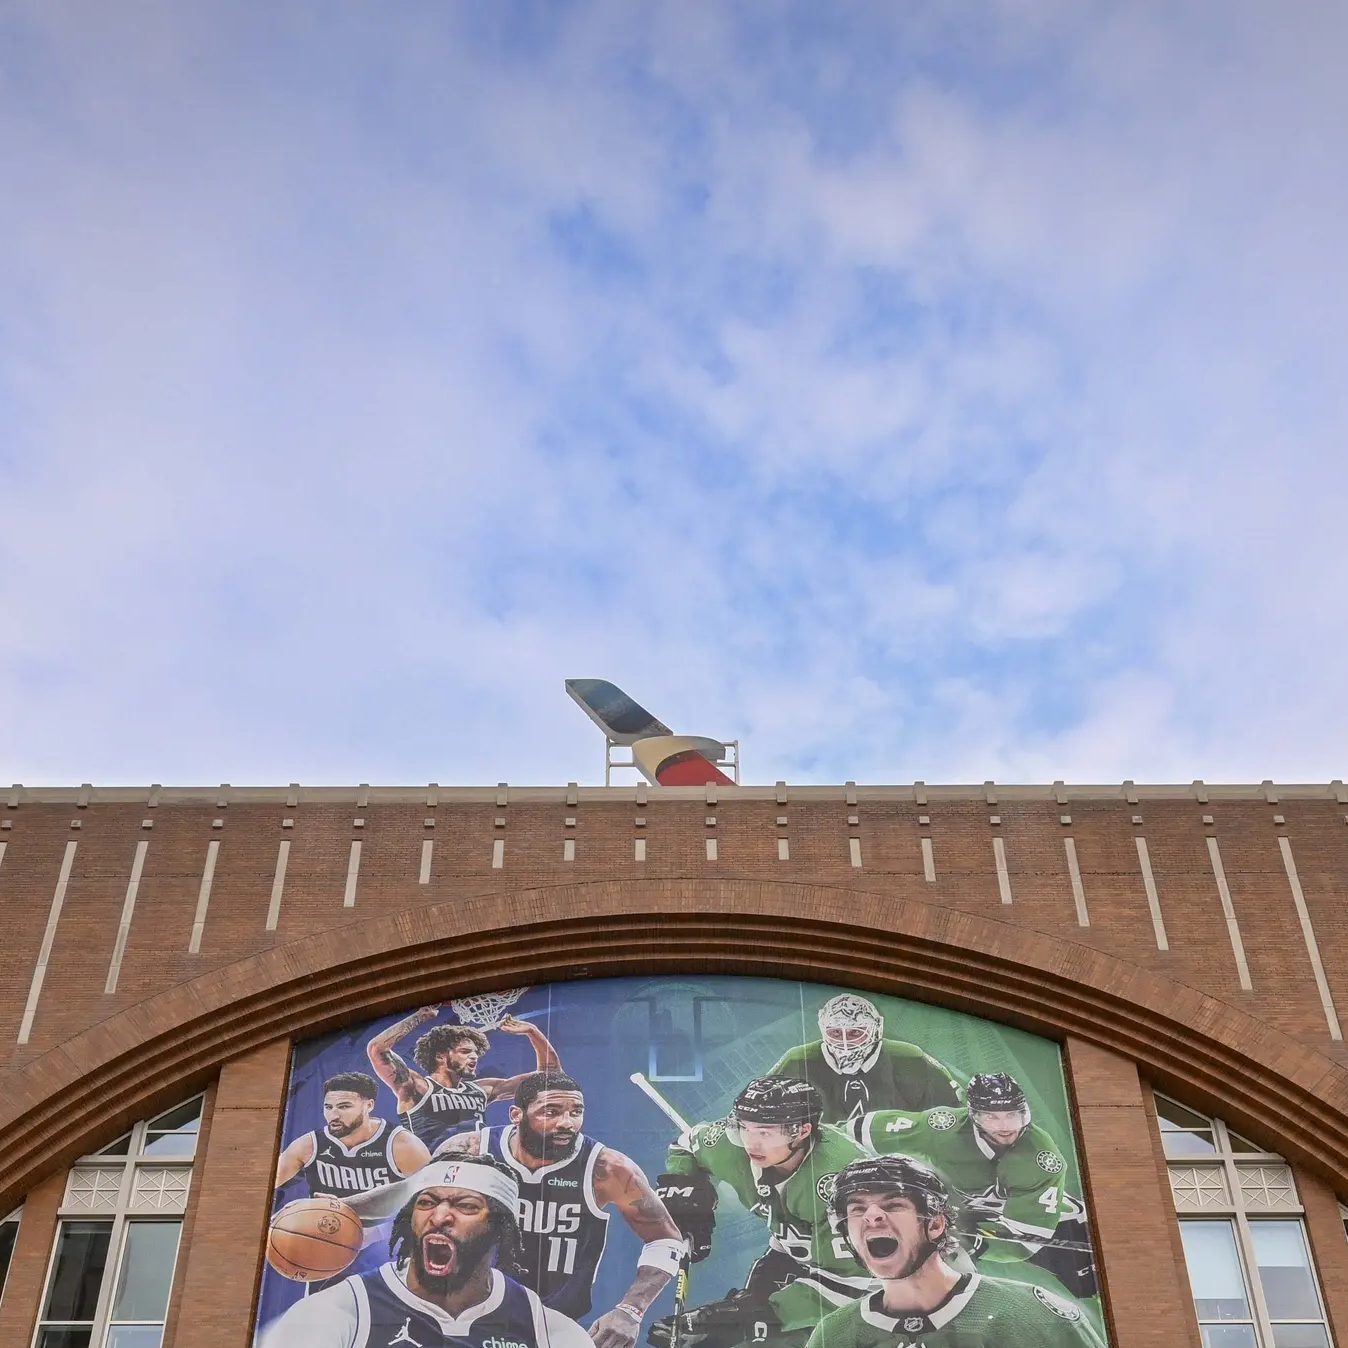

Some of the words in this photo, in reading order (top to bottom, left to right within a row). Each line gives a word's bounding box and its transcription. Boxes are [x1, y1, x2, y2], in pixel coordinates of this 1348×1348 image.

[316, 1159, 391, 1190] MAVS
[547, 1177, 578, 1188] chime
[655, 1186, 695, 1200] CM
[1038, 1186, 1059, 1214] 4
[517, 1198, 581, 1234] AVS
[547, 1236, 578, 1275] 11
